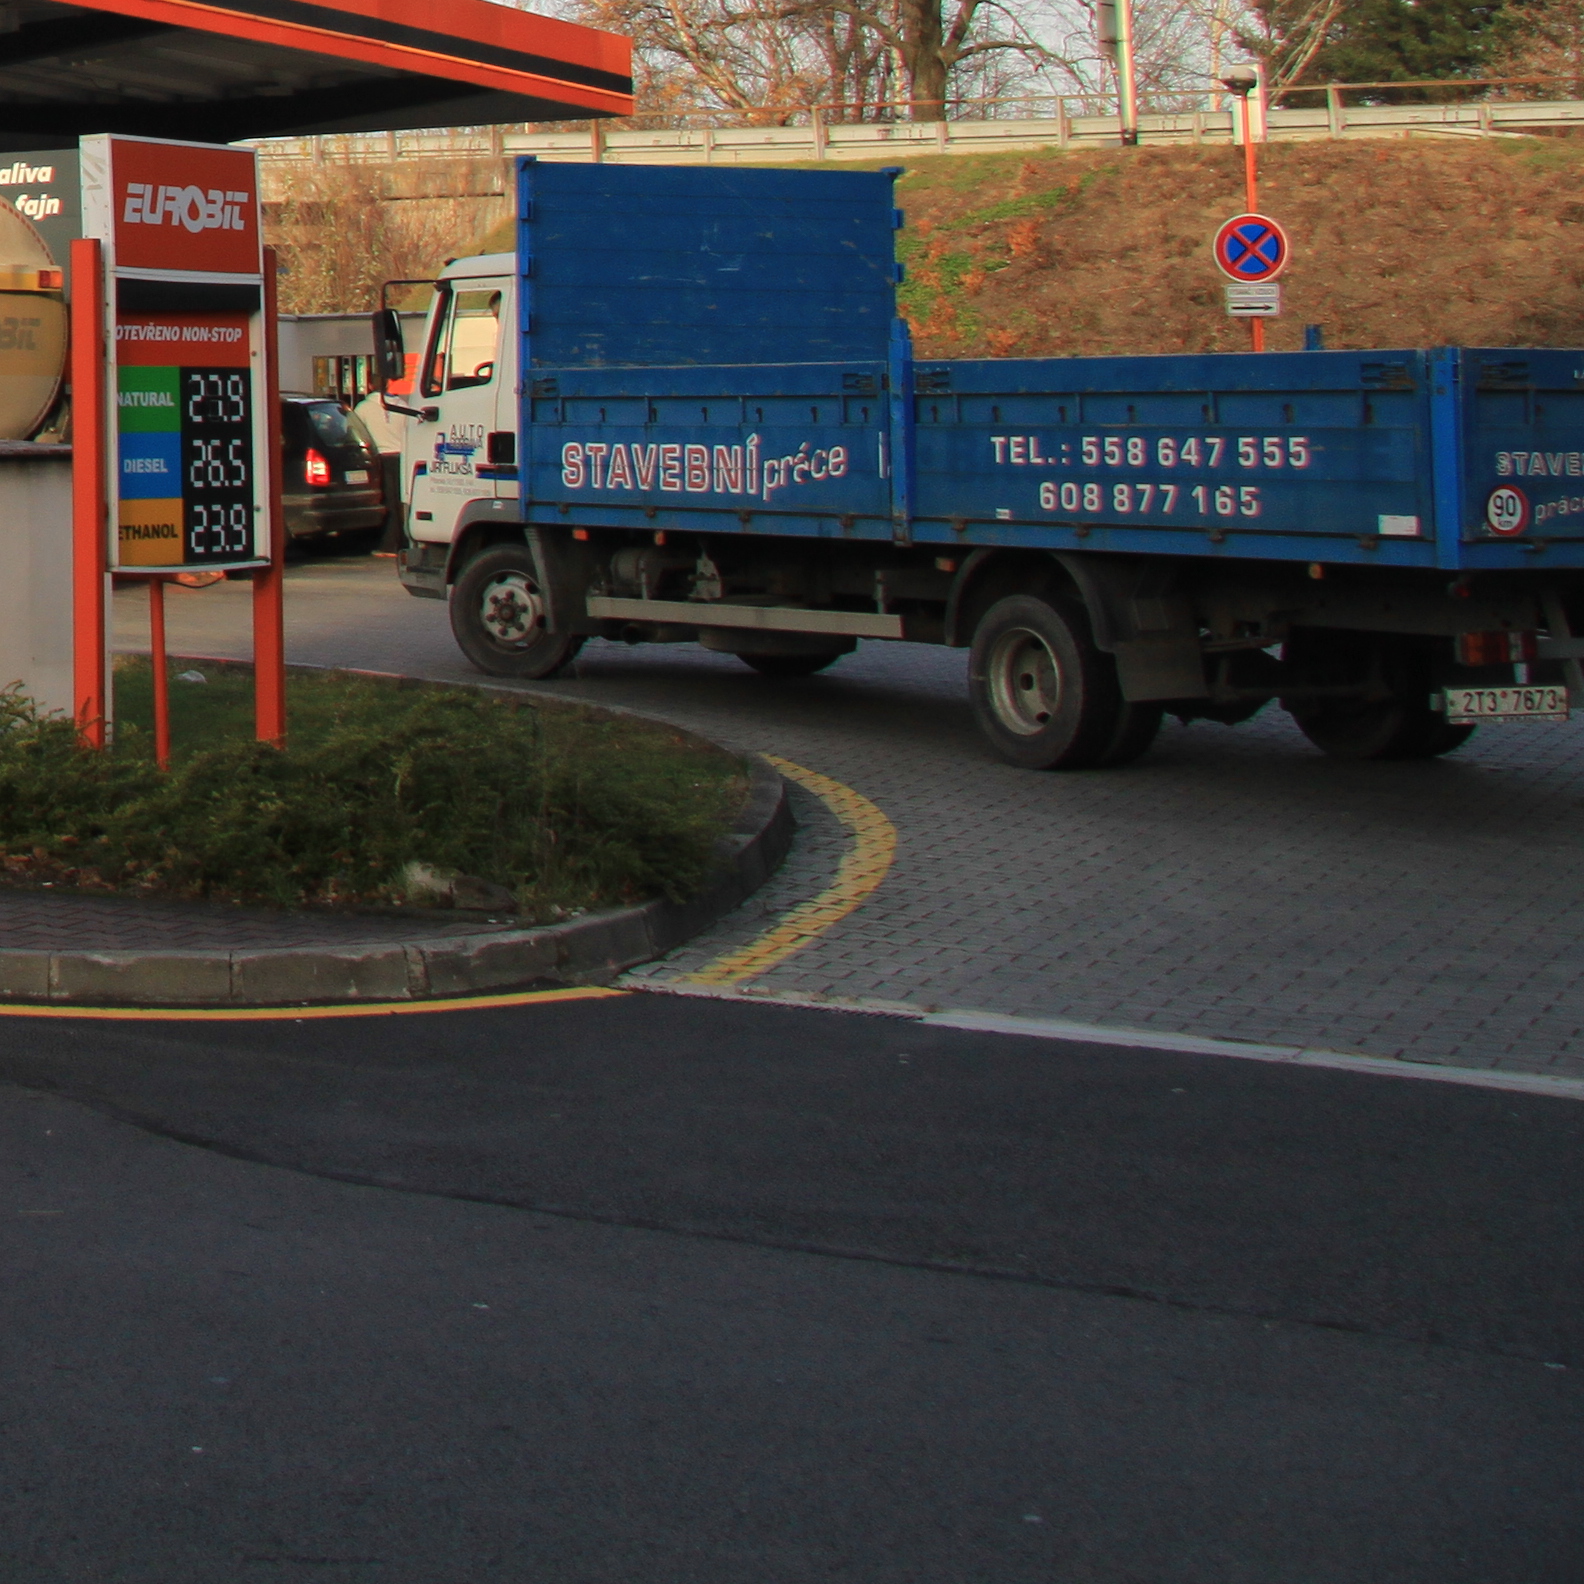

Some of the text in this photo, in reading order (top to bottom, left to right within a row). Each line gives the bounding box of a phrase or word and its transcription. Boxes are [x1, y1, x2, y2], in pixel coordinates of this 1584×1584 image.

[15, 194, 62, 221] fajn
[124, 183, 249, 233] EUROBIT
[115, 322, 242, 342] OTEVŘENO NON-STOP
[117, 392, 175, 407] NATURAL
[450, 424, 484, 438] AUTO
[123, 439, 246, 488] DIESEL 26.5
[990, 436, 1310, 468] TEL.: 558 647 555
[1495, 451, 1584, 477] STAVE
[562, 433, 848, 502] STAVEBNÍ práce
[1038, 481, 1259, 517] 608 877 165
[1493, 494, 1517, 517] 90
[1535, 495, 1584, 525] prác
[118, 523, 178, 541] ETHANOL
